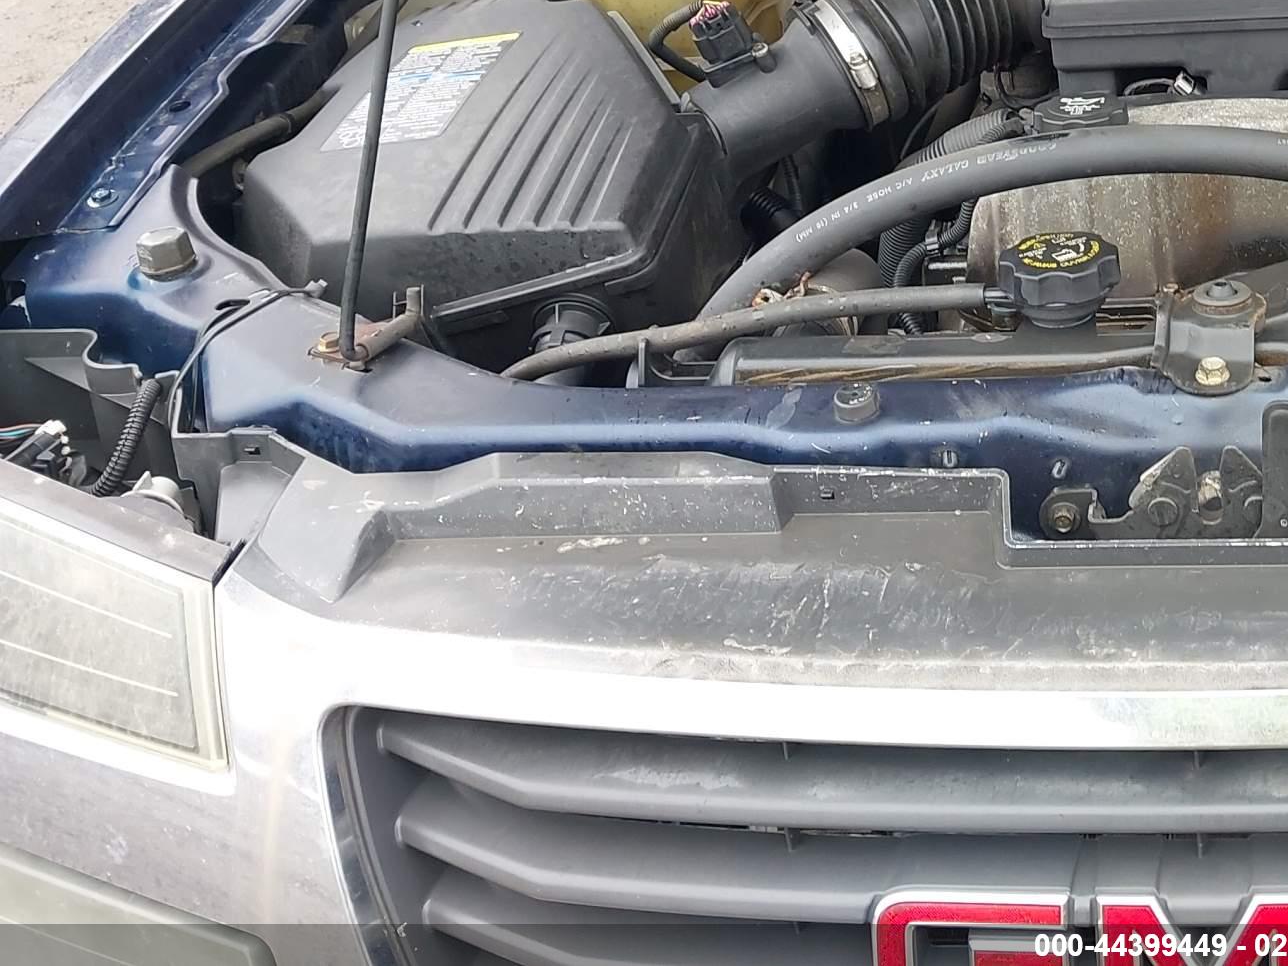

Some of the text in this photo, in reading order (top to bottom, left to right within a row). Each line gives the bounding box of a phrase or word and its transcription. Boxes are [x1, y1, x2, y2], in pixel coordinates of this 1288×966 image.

[921, 159, 969, 182] GALAXY
[895, 177, 913, 190] A/C
[866, 185, 892, 203] HOSE
[843, 201, 859, 214] 3/4
[831, 210, 841, 221] IN
